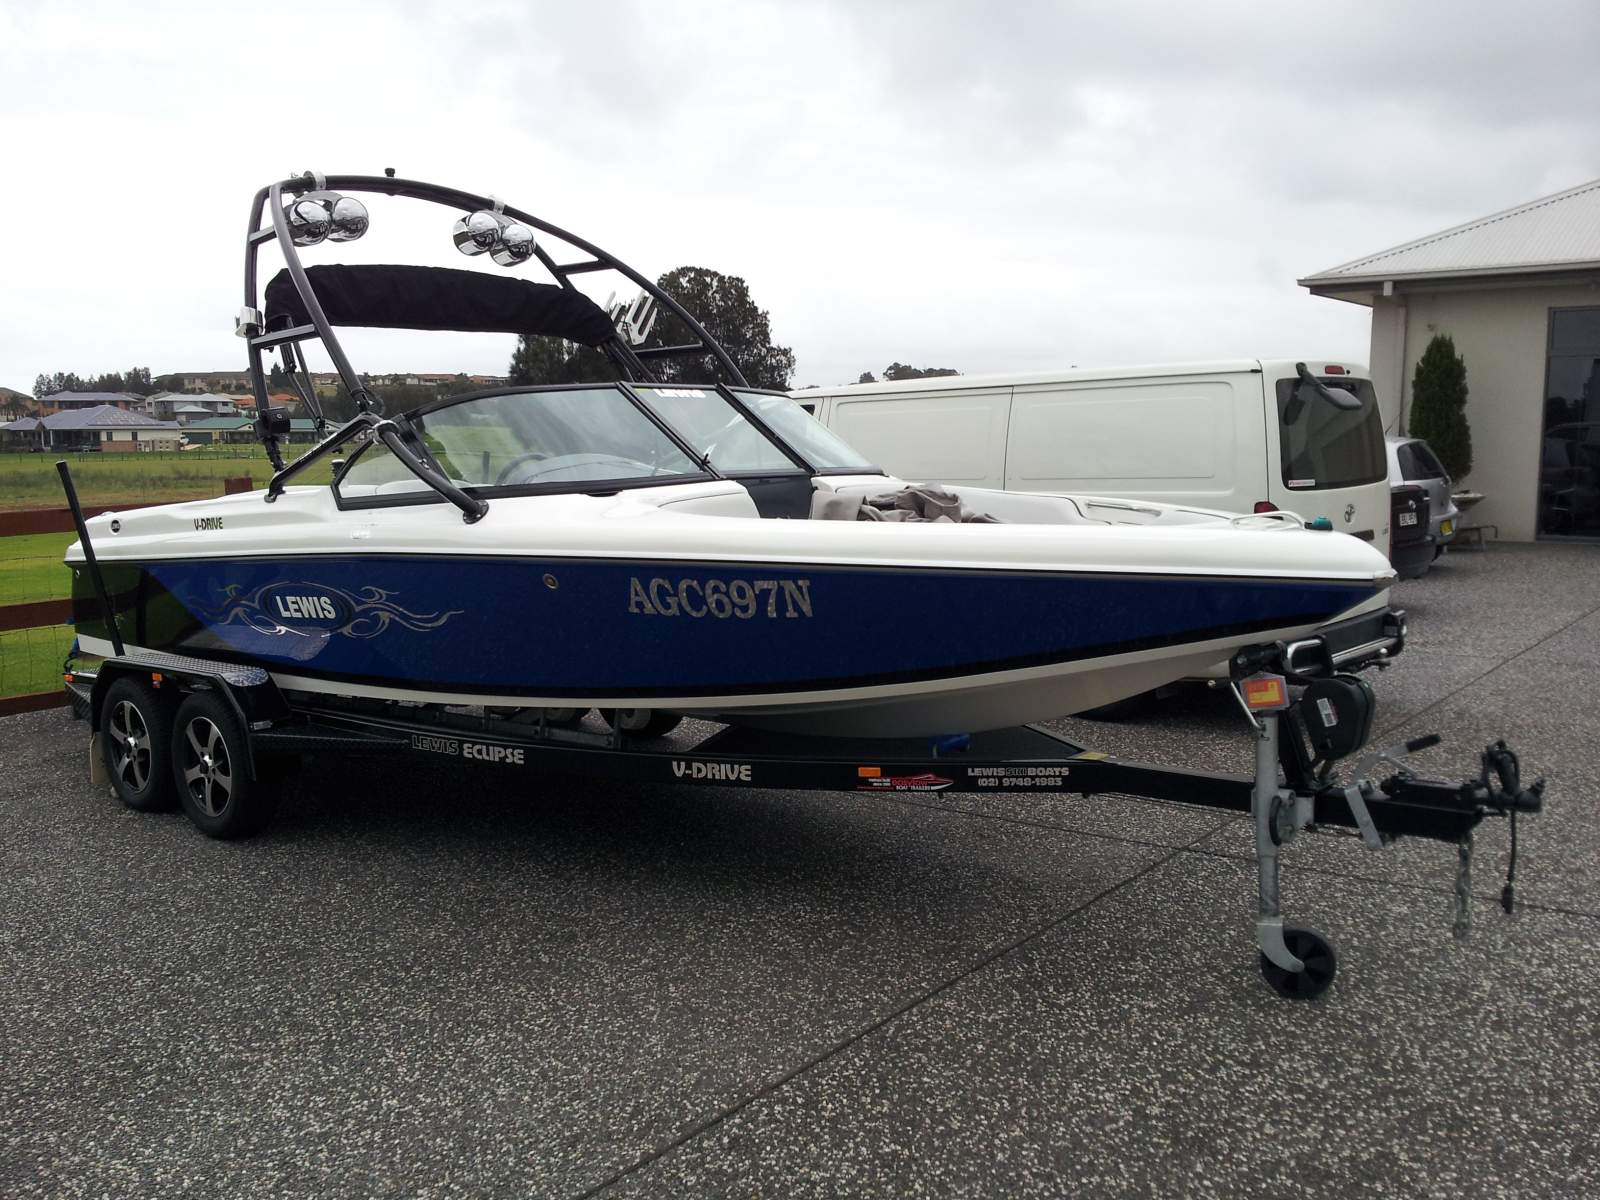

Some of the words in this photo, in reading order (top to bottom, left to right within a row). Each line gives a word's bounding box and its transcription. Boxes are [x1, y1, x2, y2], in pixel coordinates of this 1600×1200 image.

[194, 517, 223, 531] V-DRIVE
[276, 596, 336, 619] LEWIS
[628, 577, 813, 618] AGC697N
[412, 734, 459, 755] LEWIS
[463, 743, 525, 764] ECLIPSE
[672, 760, 752, 781] V-DRIVE
[968, 767, 1005, 776] LEWIS
[1027, 767, 1069, 776] BOATS
